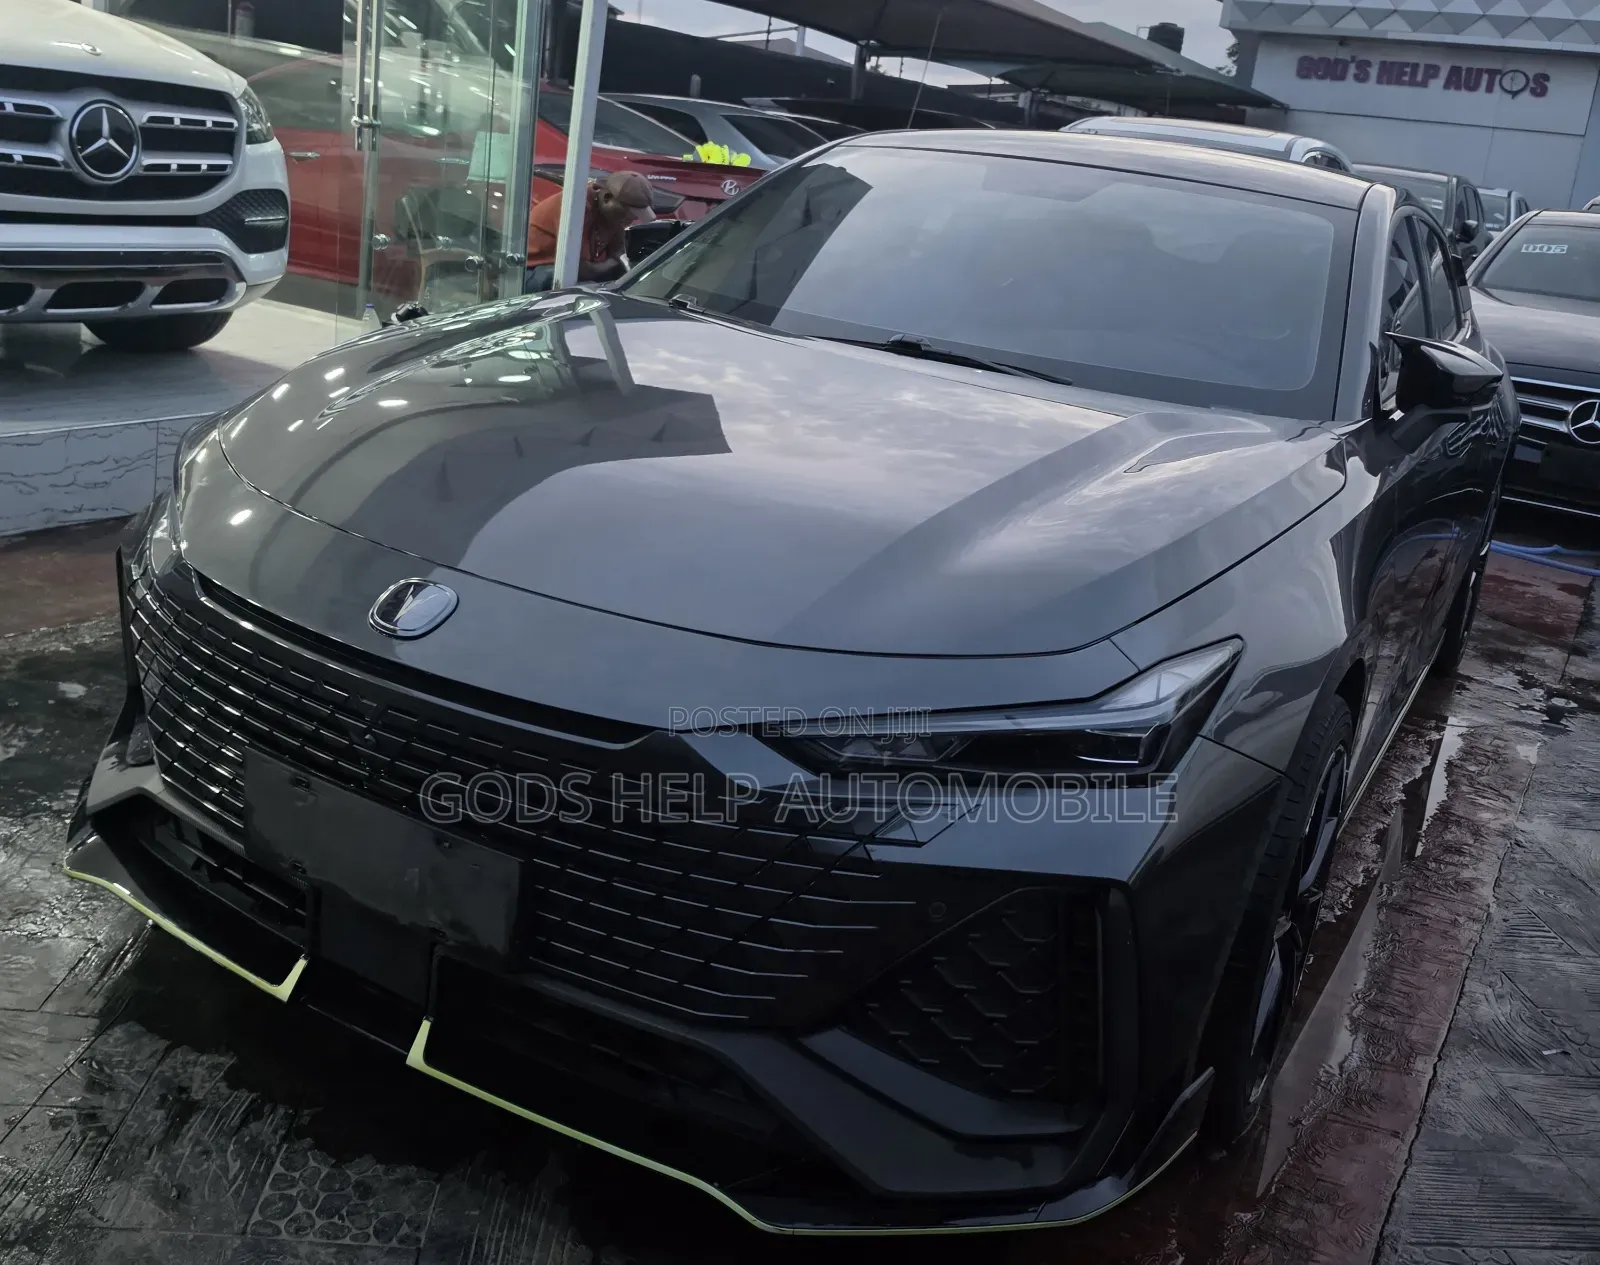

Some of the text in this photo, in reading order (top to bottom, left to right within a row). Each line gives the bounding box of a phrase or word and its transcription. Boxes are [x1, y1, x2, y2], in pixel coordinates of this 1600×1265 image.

[1296, 55, 1550, 99] GOD'S HELP AUTOS
